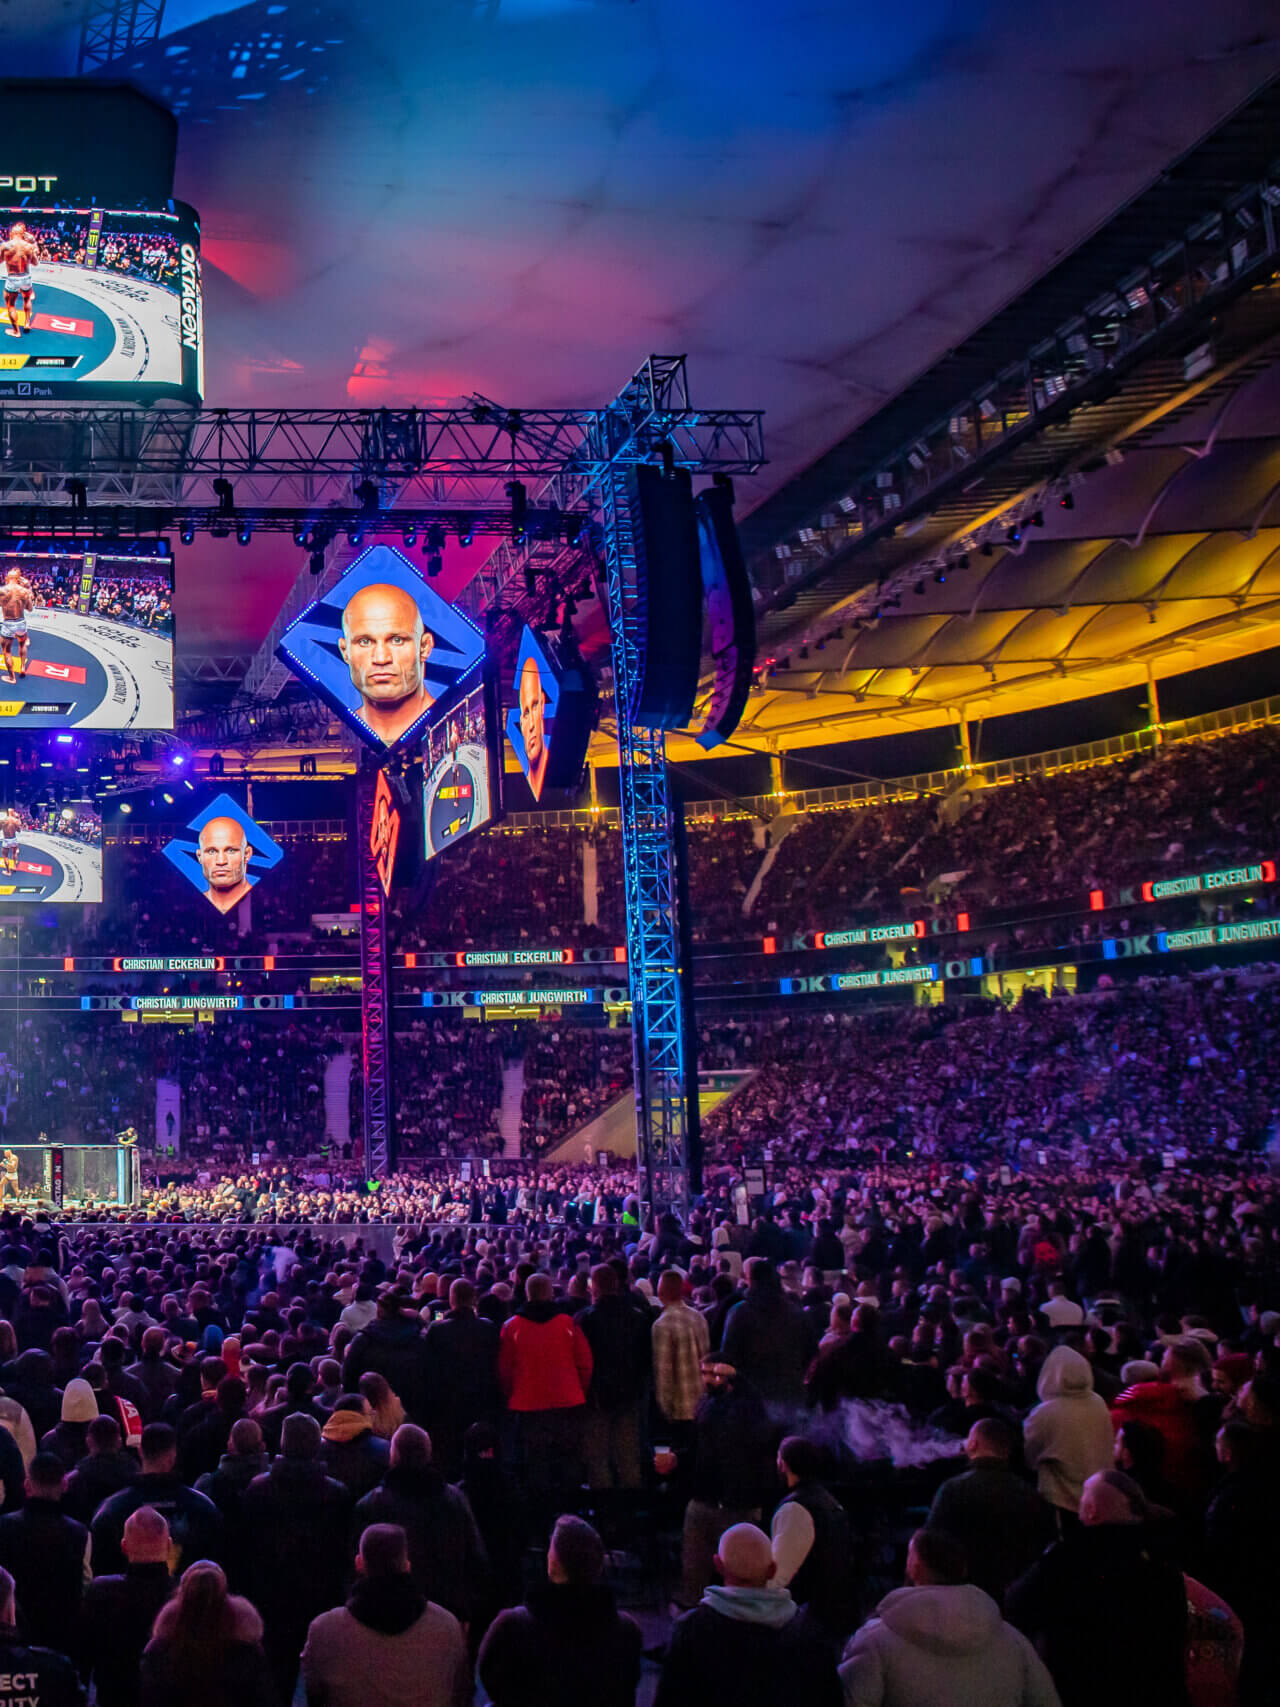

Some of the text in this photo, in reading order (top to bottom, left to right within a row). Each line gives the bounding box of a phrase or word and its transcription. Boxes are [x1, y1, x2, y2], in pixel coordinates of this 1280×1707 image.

[180, 243, 197, 351] OKTAGON
[34, 387, 53, 396] Park
[1155, 866, 1262, 897] CHRISTIAN ECKERLIN
[825, 931, 866, 946] CHRISTIAN
[871, 924, 915, 941] ECKERLIN
[1167, 929, 1213, 948] CHRISTIAN
[1219, 920, 1280, 941] JUNGWIRT
[123, 958, 215, 970] CHRISTIAN ECKERLIN
[466, 951, 563, 965] CHRISTIAN ECKERLIN
[838, 973, 878, 988] CHRISTIAN
[884, 967, 933, 984] JUNGWIRTH
[136, 997, 177, 1008] CHRISTIAN
[181, 997, 238, 1008] JUNGWIRTH
[481, 992, 523, 1004] CHRISTIAN
[528, 991, 587, 1003] JUNGWIRTH
